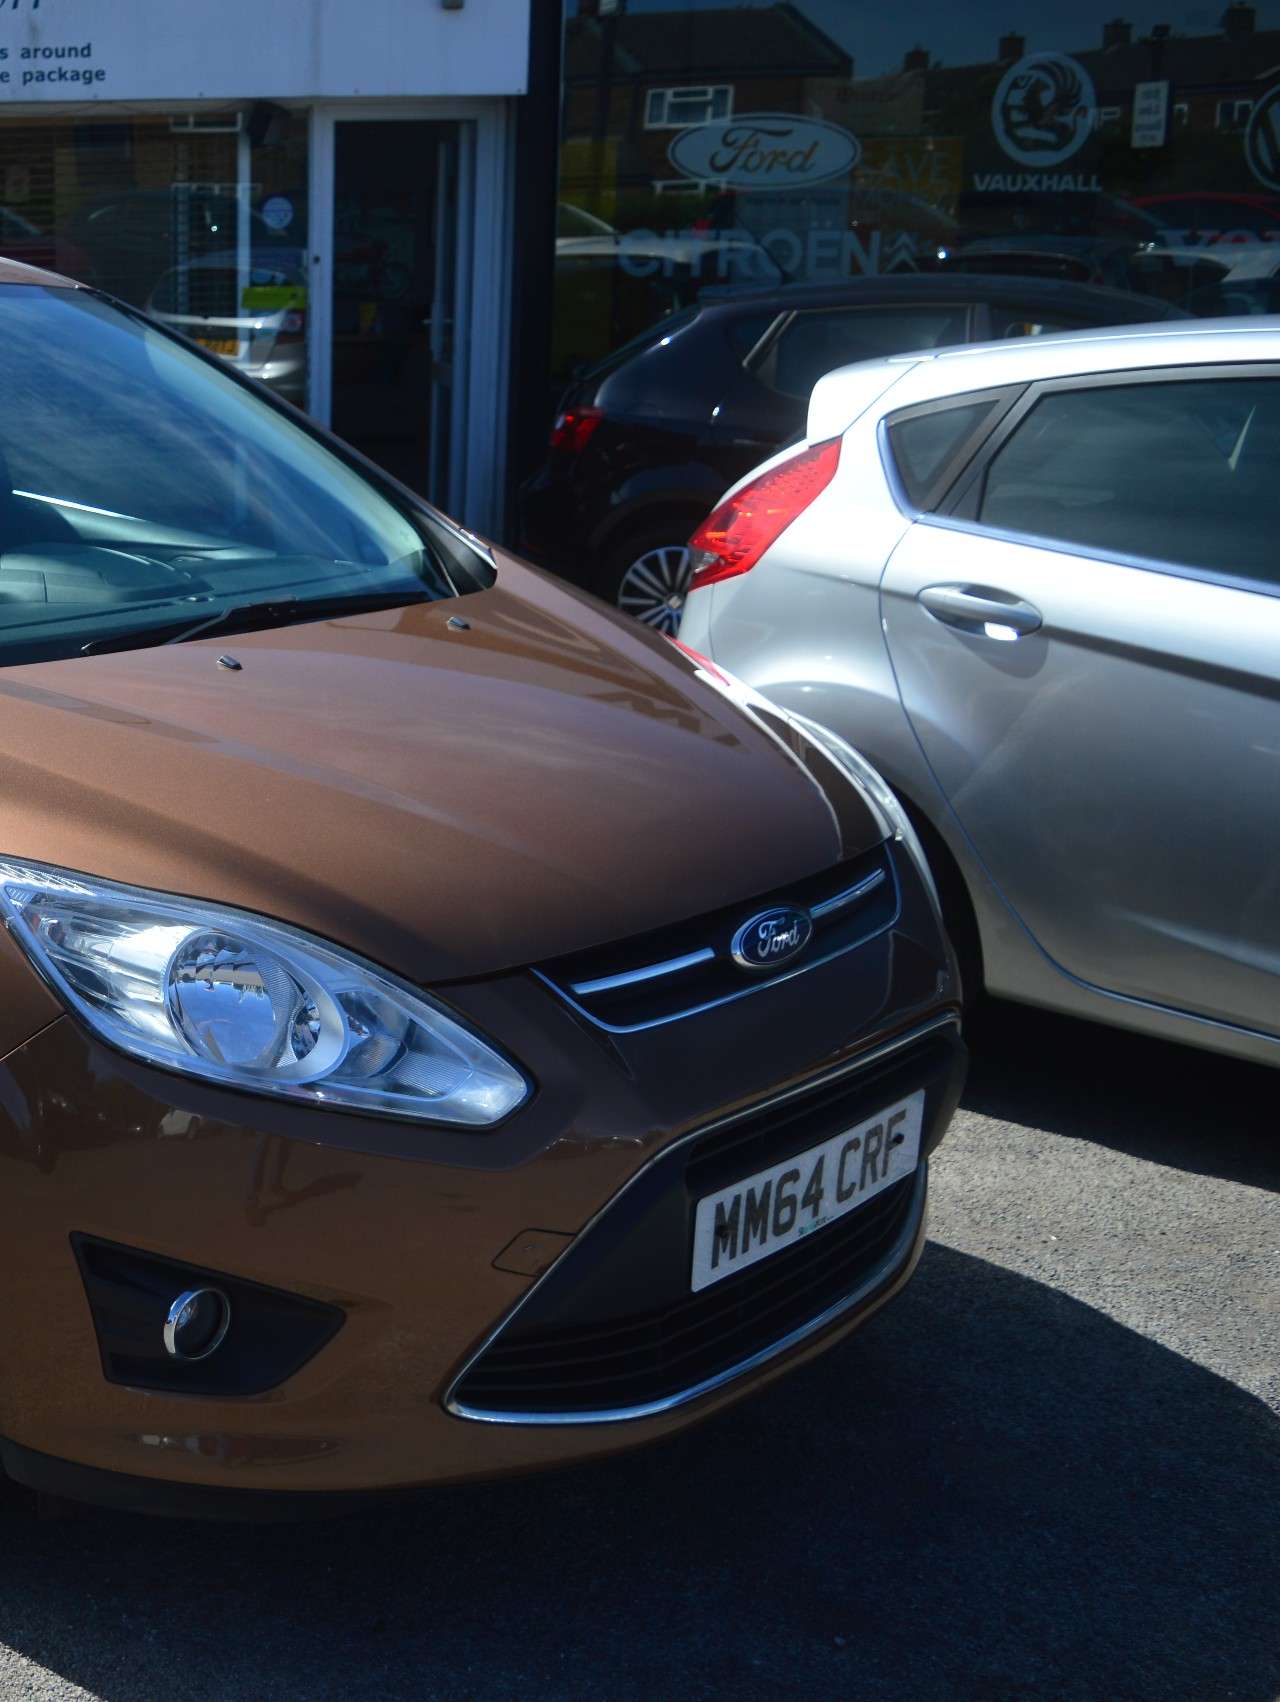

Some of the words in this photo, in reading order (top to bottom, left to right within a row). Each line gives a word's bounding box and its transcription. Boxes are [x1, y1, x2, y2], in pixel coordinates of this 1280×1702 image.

[20, 42, 92, 60] around
[22, 66, 106, 87] package
[709, 127, 819, 174] Ford
[973, 173, 1103, 193] VAUXHALL
[756, 916, 801, 958] Ford
[710, 1156, 827, 1270] MM64
[835, 1109, 908, 1204] CRF
